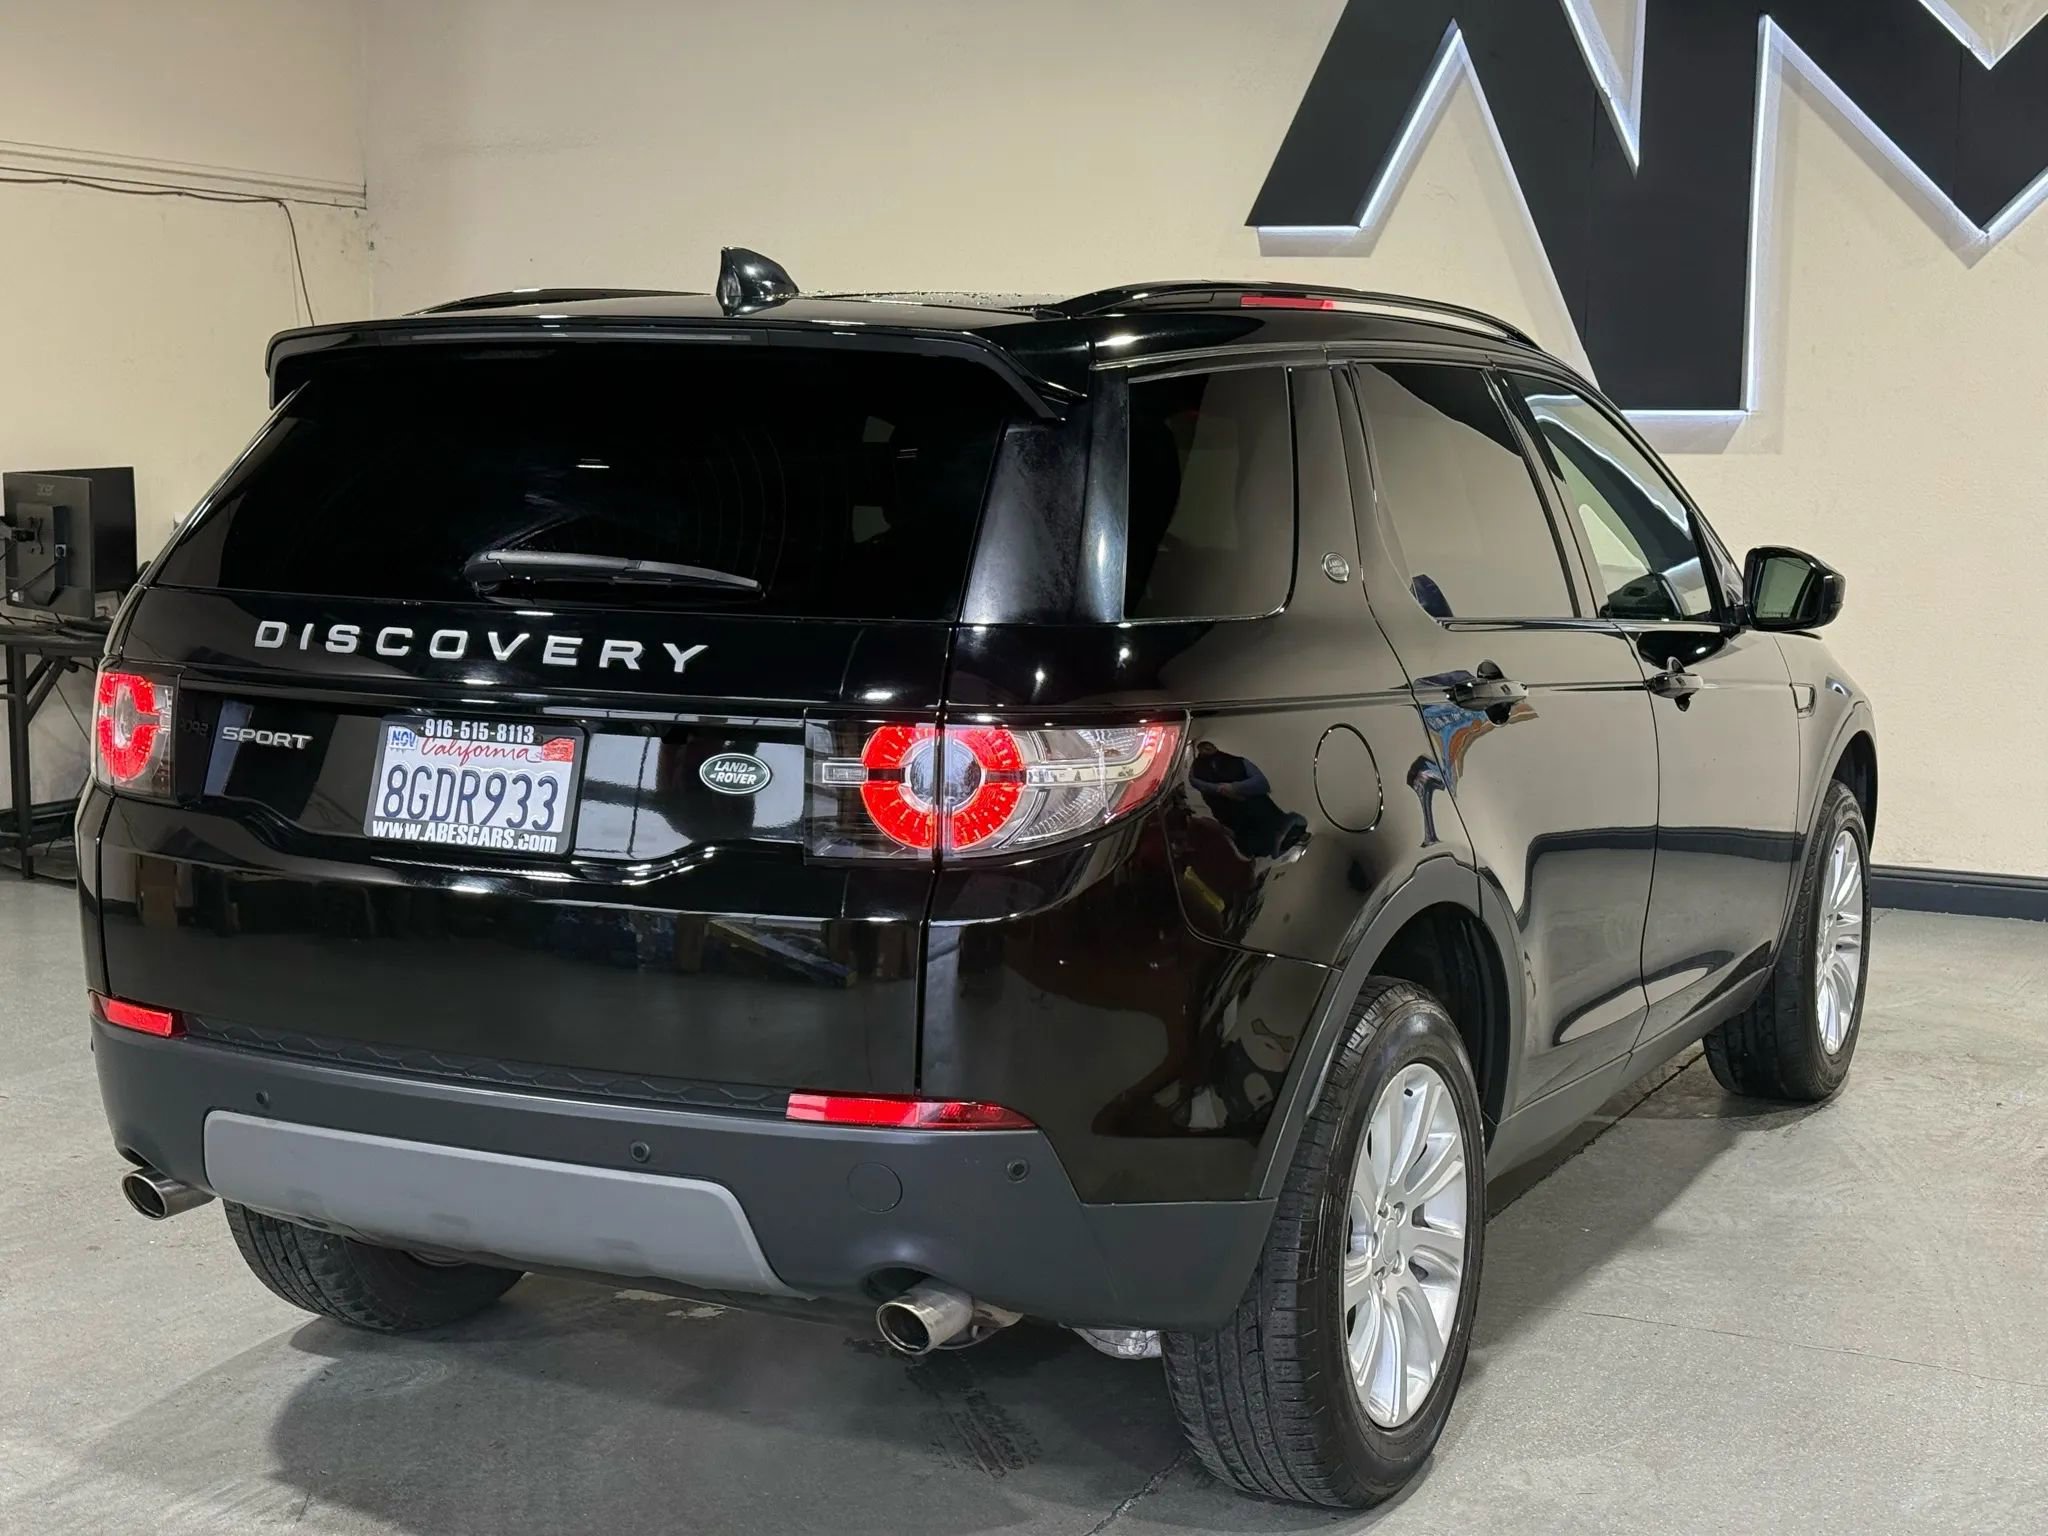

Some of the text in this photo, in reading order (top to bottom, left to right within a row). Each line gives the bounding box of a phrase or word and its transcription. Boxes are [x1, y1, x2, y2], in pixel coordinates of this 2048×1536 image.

[254, 620, 708, 672] DISCOVERY
[221, 726, 313, 749] SPORT
[423, 718, 535, 743] 916-515-8113
[421, 734, 542, 767] California
[714, 760, 748, 773] LAND
[715, 771, 757, 785] ROVER
[382, 763, 559, 832] 8GDR933
